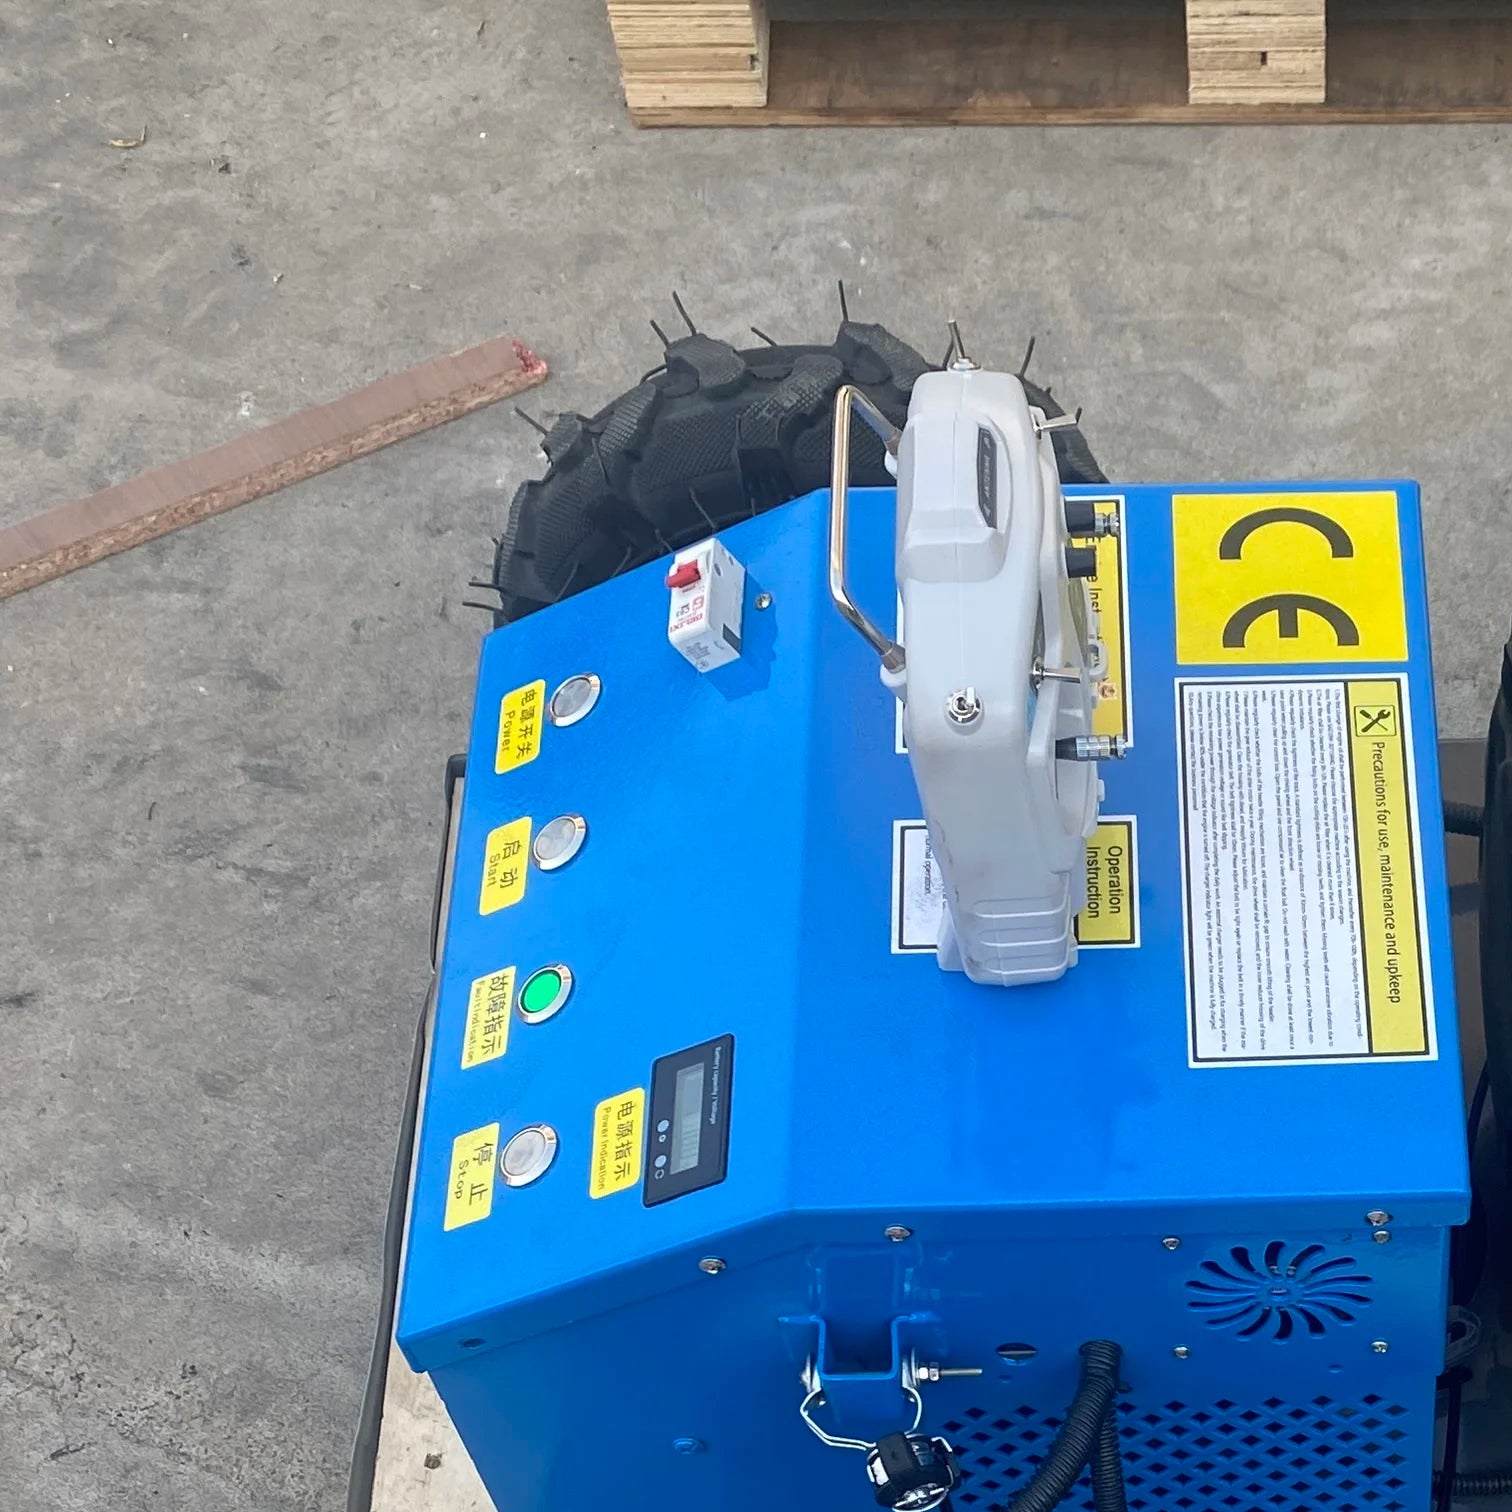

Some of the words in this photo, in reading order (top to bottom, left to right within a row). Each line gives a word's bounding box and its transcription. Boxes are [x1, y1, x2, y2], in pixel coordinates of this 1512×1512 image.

[1219, 506, 1360, 648] CE
[502, 710, 516, 752] Power
[516, 689, 537, 759] 电源开关
[1370, 741, 1390, 807] Precautions
[1373, 828, 1391, 851] use,
[1374, 809, 1391, 826] for
[487, 853, 500, 887] Start
[500, 840, 522, 888] 启动
[1087, 847, 1103, 919] Instruction
[1105, 846, 1124, 914] Operation
[1378, 854, 1399, 929] maintenance
[1383, 932, 1401, 955] and
[1380, 958, 1404, 1004] upkeep
[482, 973, 509, 1056] 故障指示
[601, 1106, 612, 1138] Power
[614, 1101, 635, 1181] 电源指示
[455, 1160, 469, 1199] Stop
[469, 1143, 494, 1205] 停止
[597, 1140, 610, 1191] Indication
